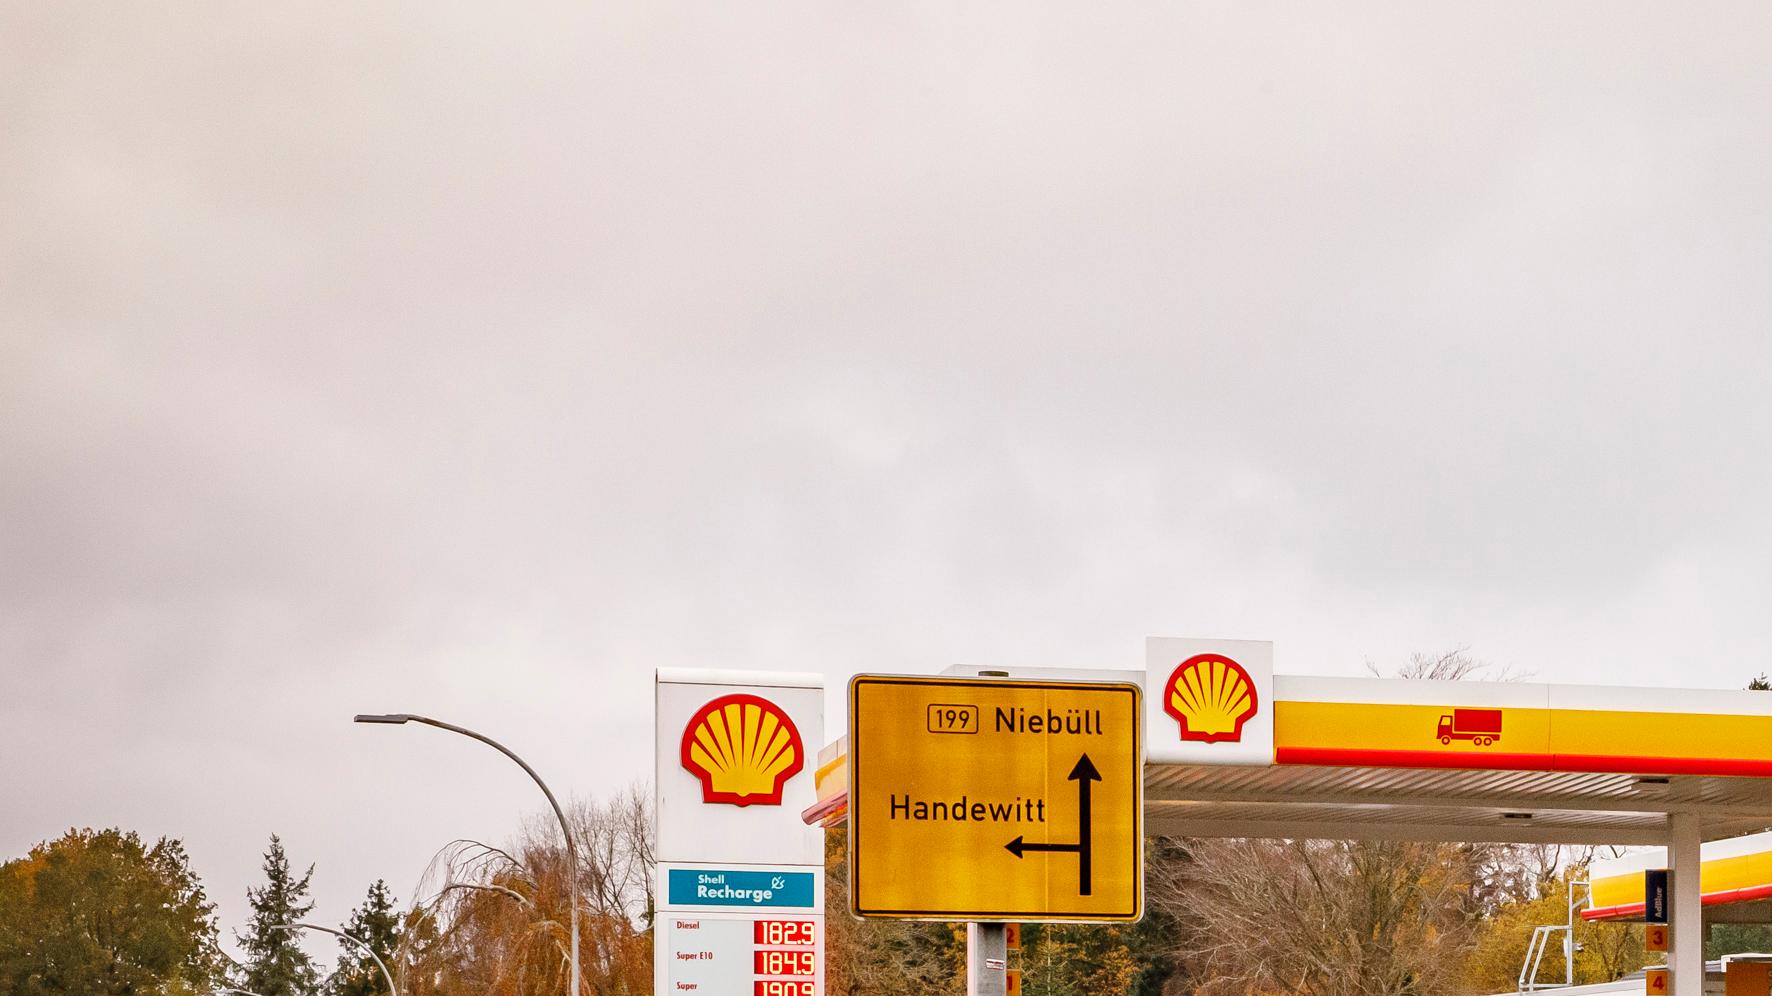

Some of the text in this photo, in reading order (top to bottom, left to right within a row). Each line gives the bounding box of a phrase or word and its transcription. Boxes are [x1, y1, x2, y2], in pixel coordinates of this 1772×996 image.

[936, 707, 1103, 735] 199 Niebüll
[890, 794, 1046, 823] Handewitt
[698, 874, 725, 885] Shell
[697, 884, 773, 903] Recharge
[1655, 887, 1663, 918] AdBlue
[676, 921, 815, 945] Diesel 182.9
[1653, 930, 1663, 946] 3
[676, 951, 815, 975] Super E10 184.9
[676, 981, 698, 991] Super
[1652, 976, 1664, 990] 4
